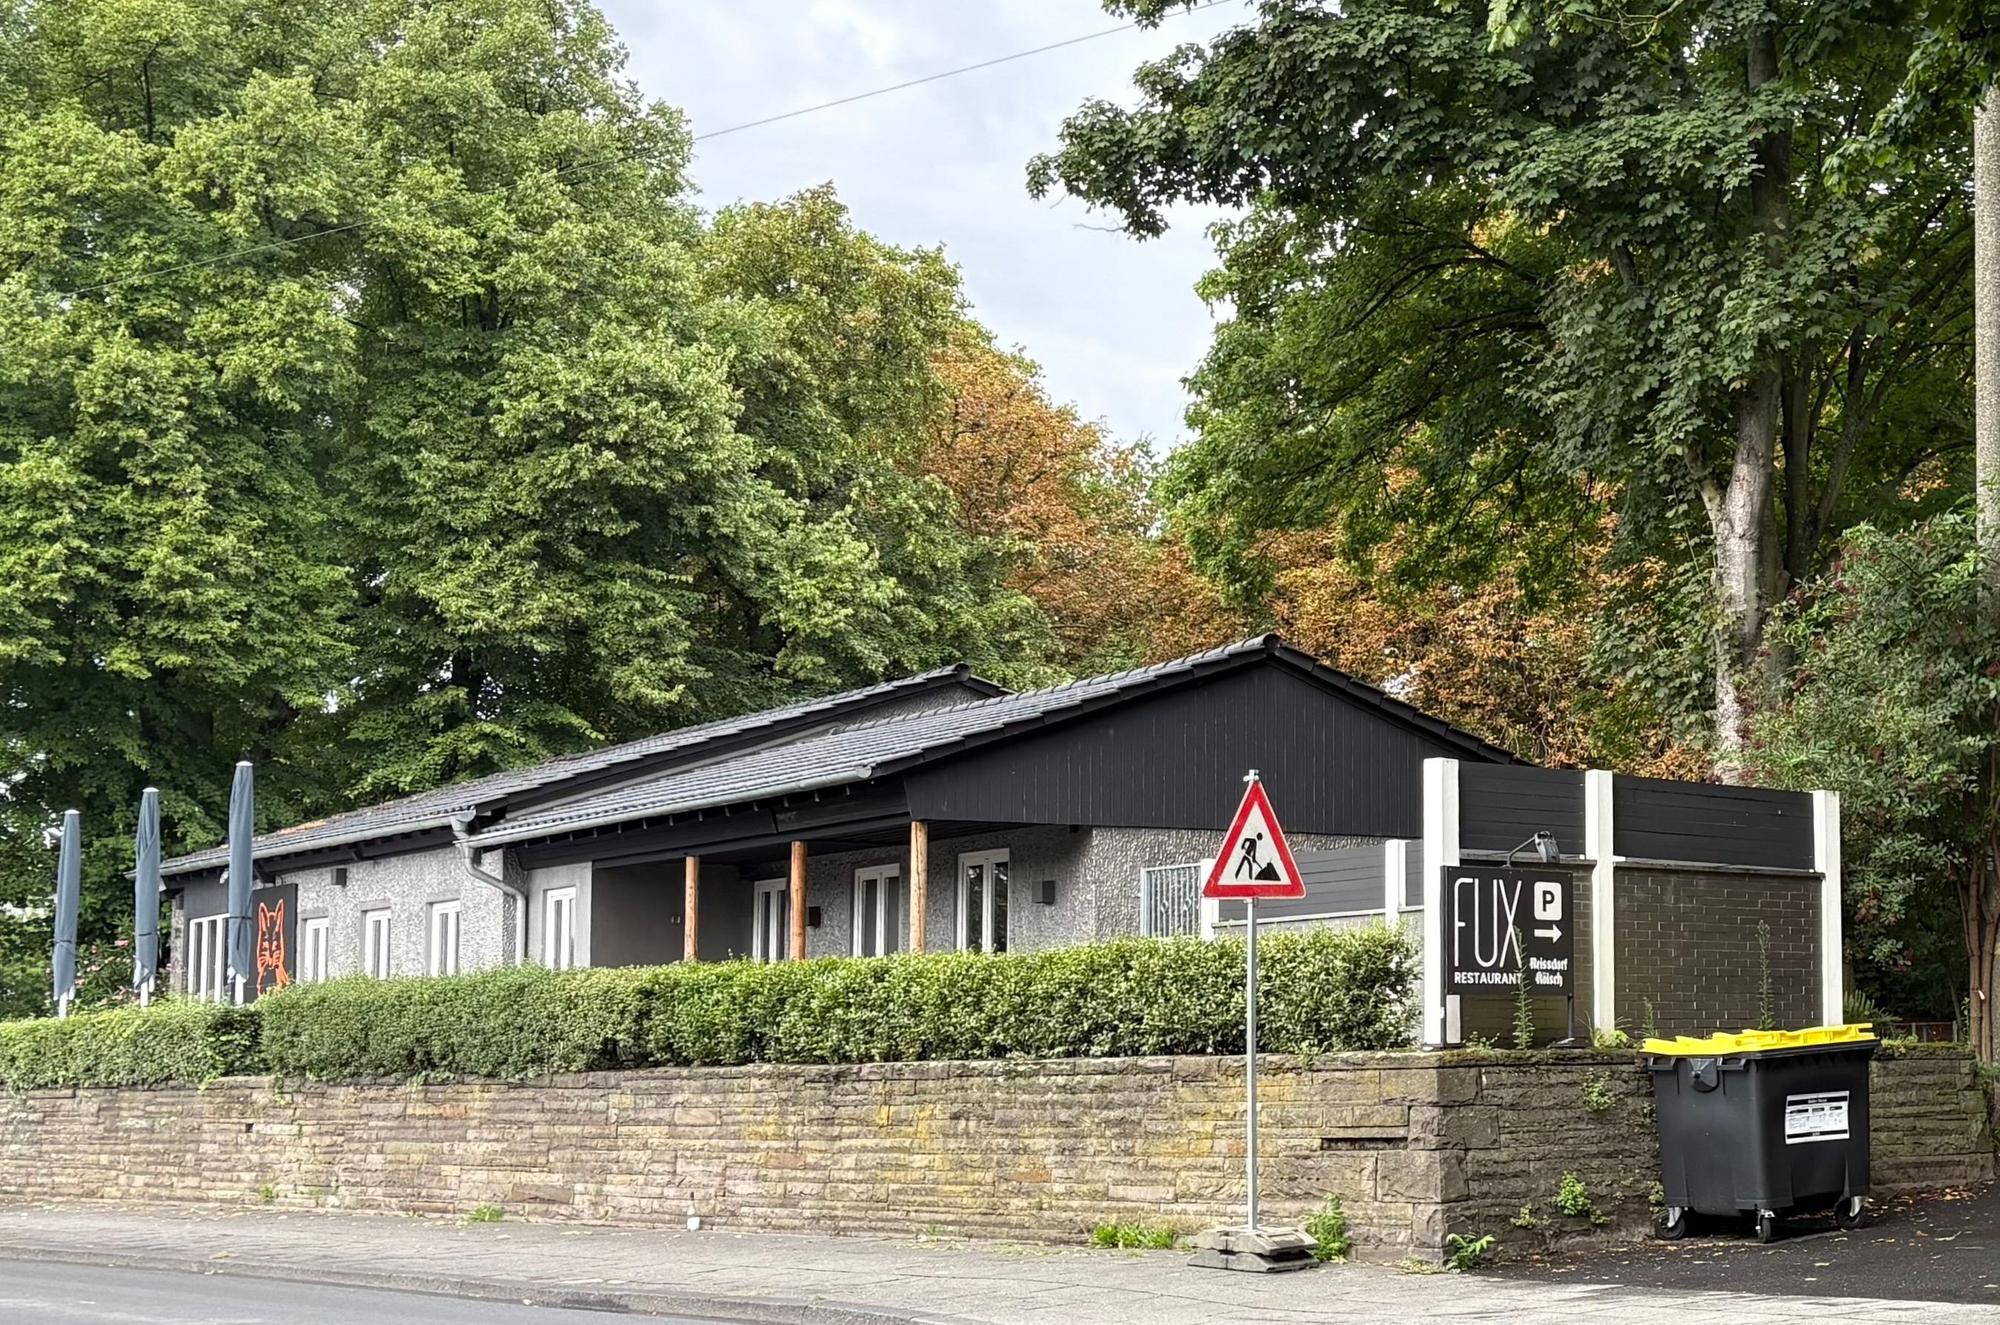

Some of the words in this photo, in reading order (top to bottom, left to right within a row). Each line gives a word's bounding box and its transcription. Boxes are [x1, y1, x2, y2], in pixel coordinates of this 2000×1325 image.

[1542, 890, 1555, 912] P
[1454, 877, 1523, 968] FUX
[1454, 972, 1523, 984] RESTAURANT
